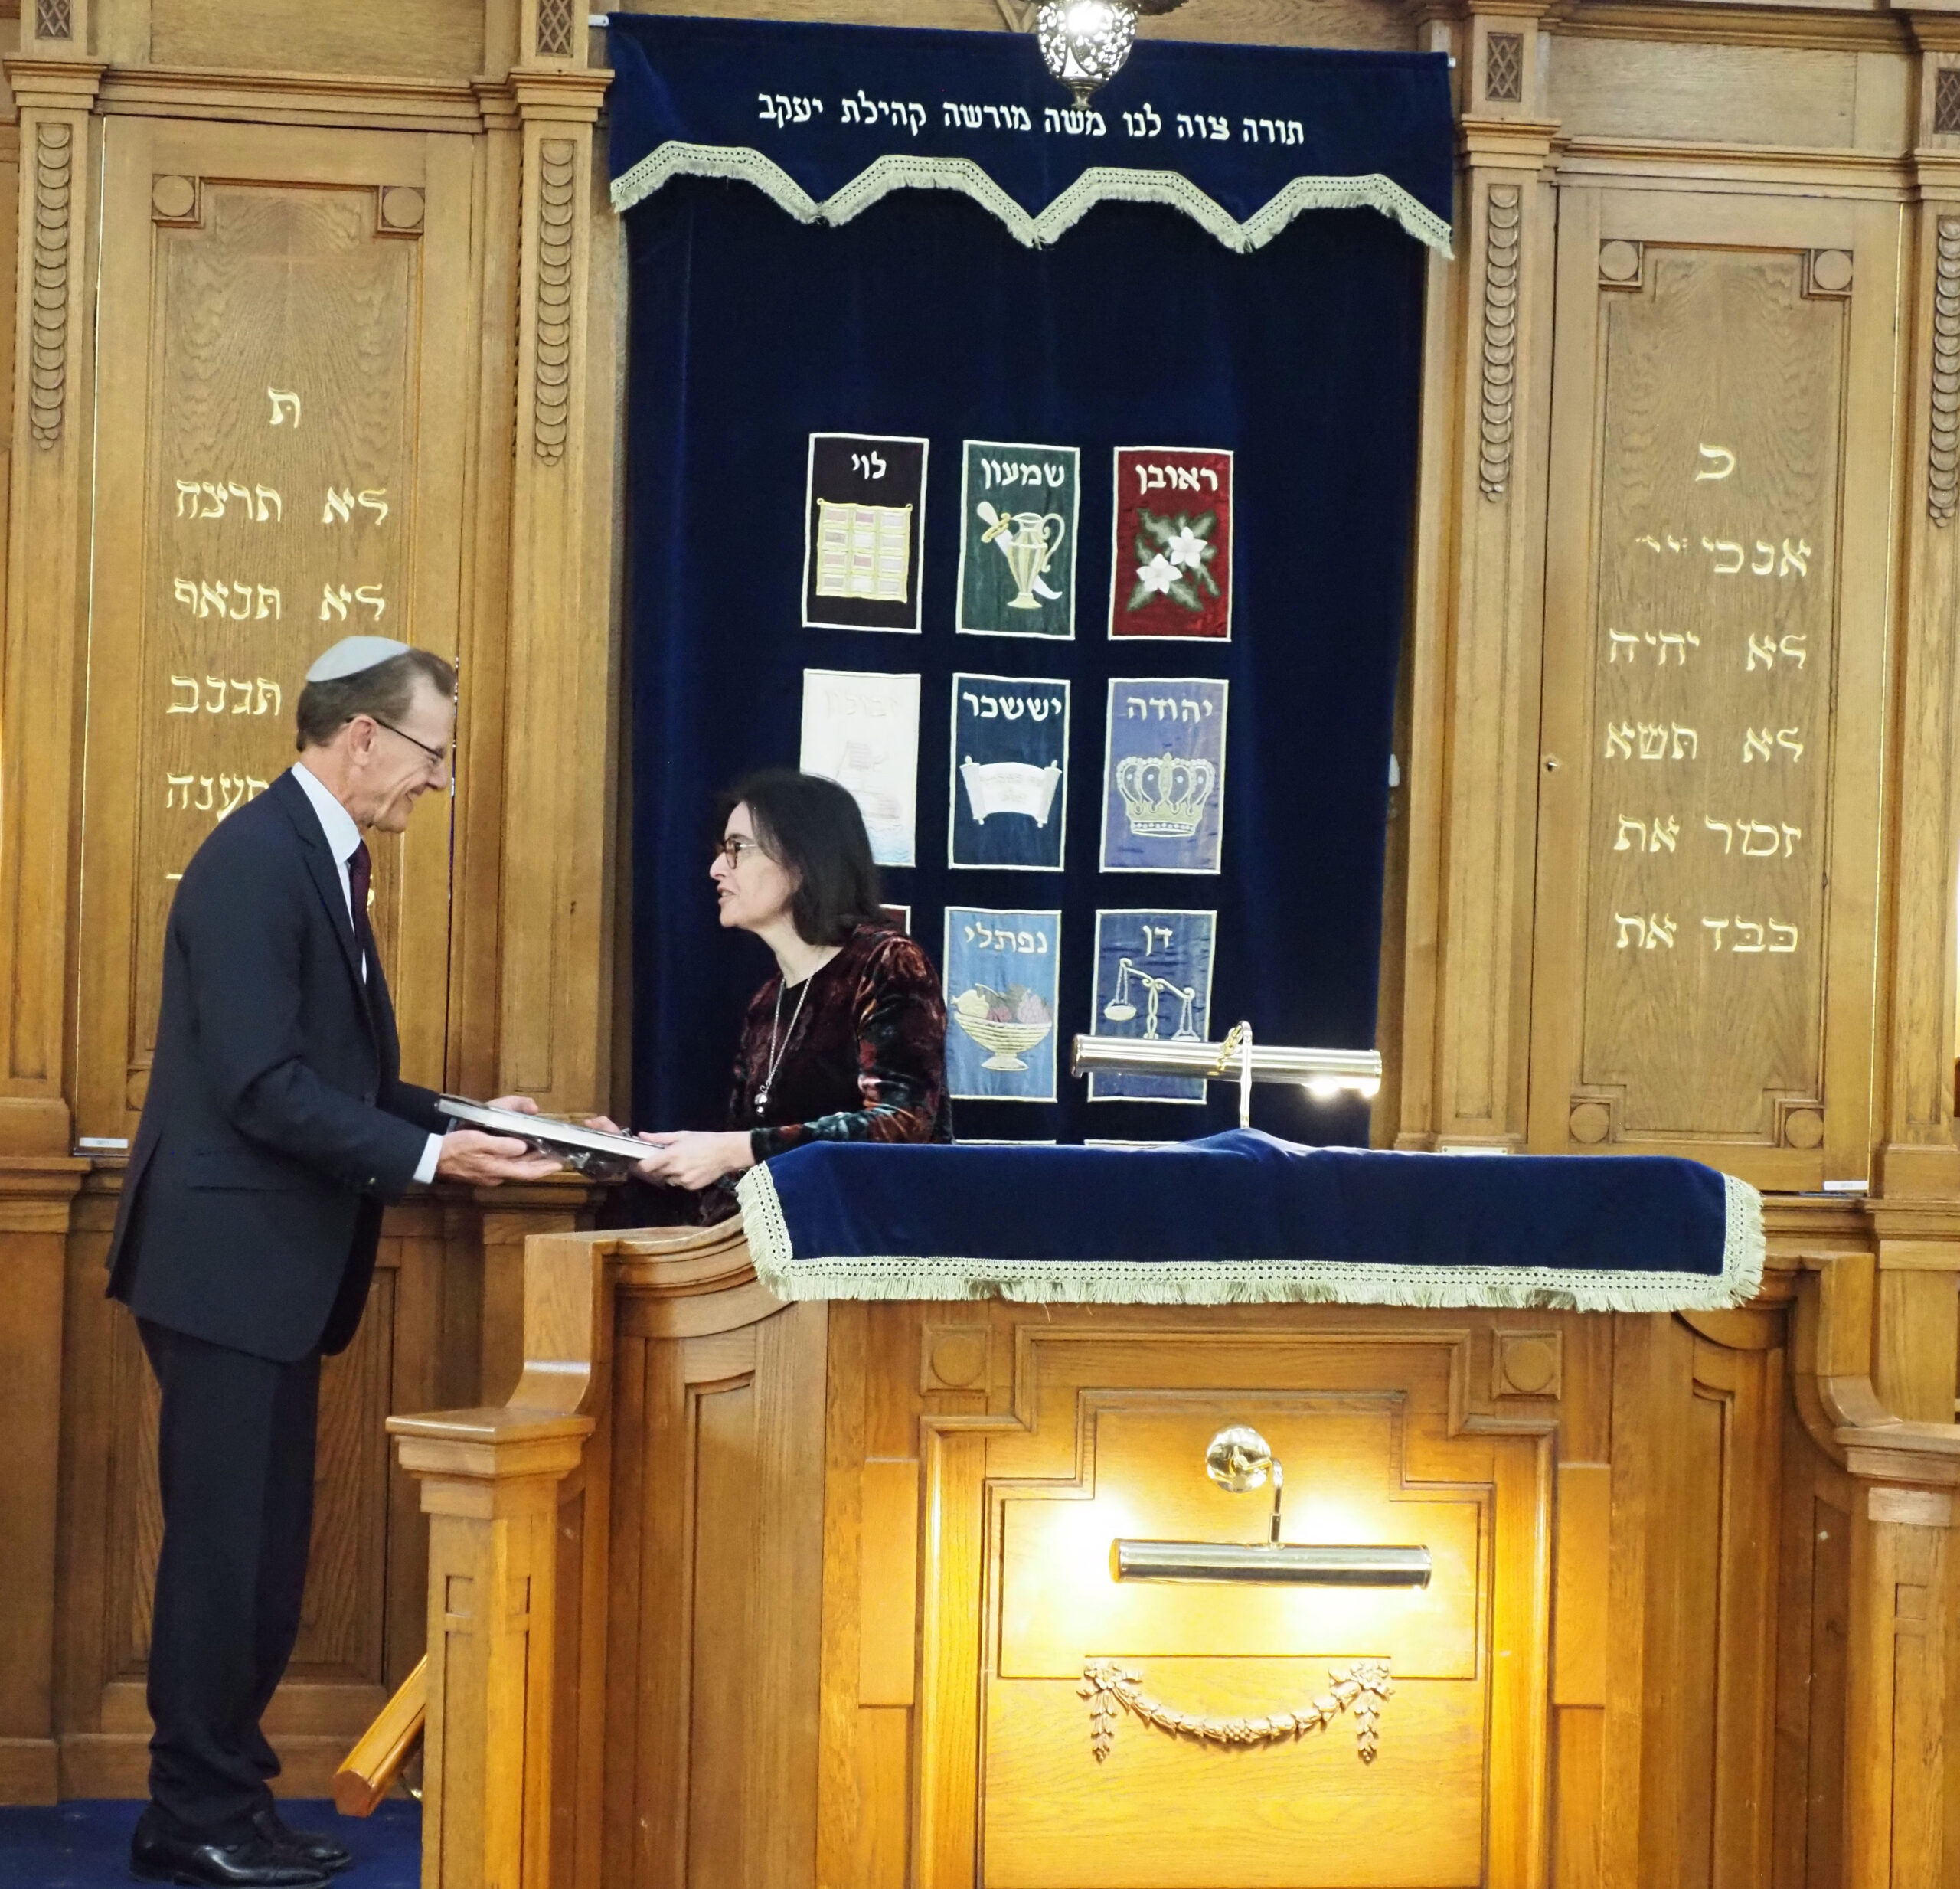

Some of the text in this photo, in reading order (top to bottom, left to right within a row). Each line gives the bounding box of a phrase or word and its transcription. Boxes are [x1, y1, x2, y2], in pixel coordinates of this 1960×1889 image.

[758, 90, 1305, 145] תורה צוה לנו משה מורשה קהילת יעקב
[851, 450, 887, 479] לוי
[981, 458, 1065, 490] שמעון
[1135, 464, 1218, 495] ראובן
[176, 479, 389, 525] לא תרצח
[1701, 536, 1811, 577] אנכי
[318, 583, 385, 622] לא
[1609, 628, 1807, 672] לא יהיה
[962, 691, 1062, 722] יששכר
[1126, 697, 1214, 724] יהודה
[1743, 727, 1804, 763] לא
[1613, 814, 1680, 853] את
[964, 921, 1048, 953] נפתלי
[1142, 925, 1173, 956] דן
[1614, 912, 1677, 949] את
